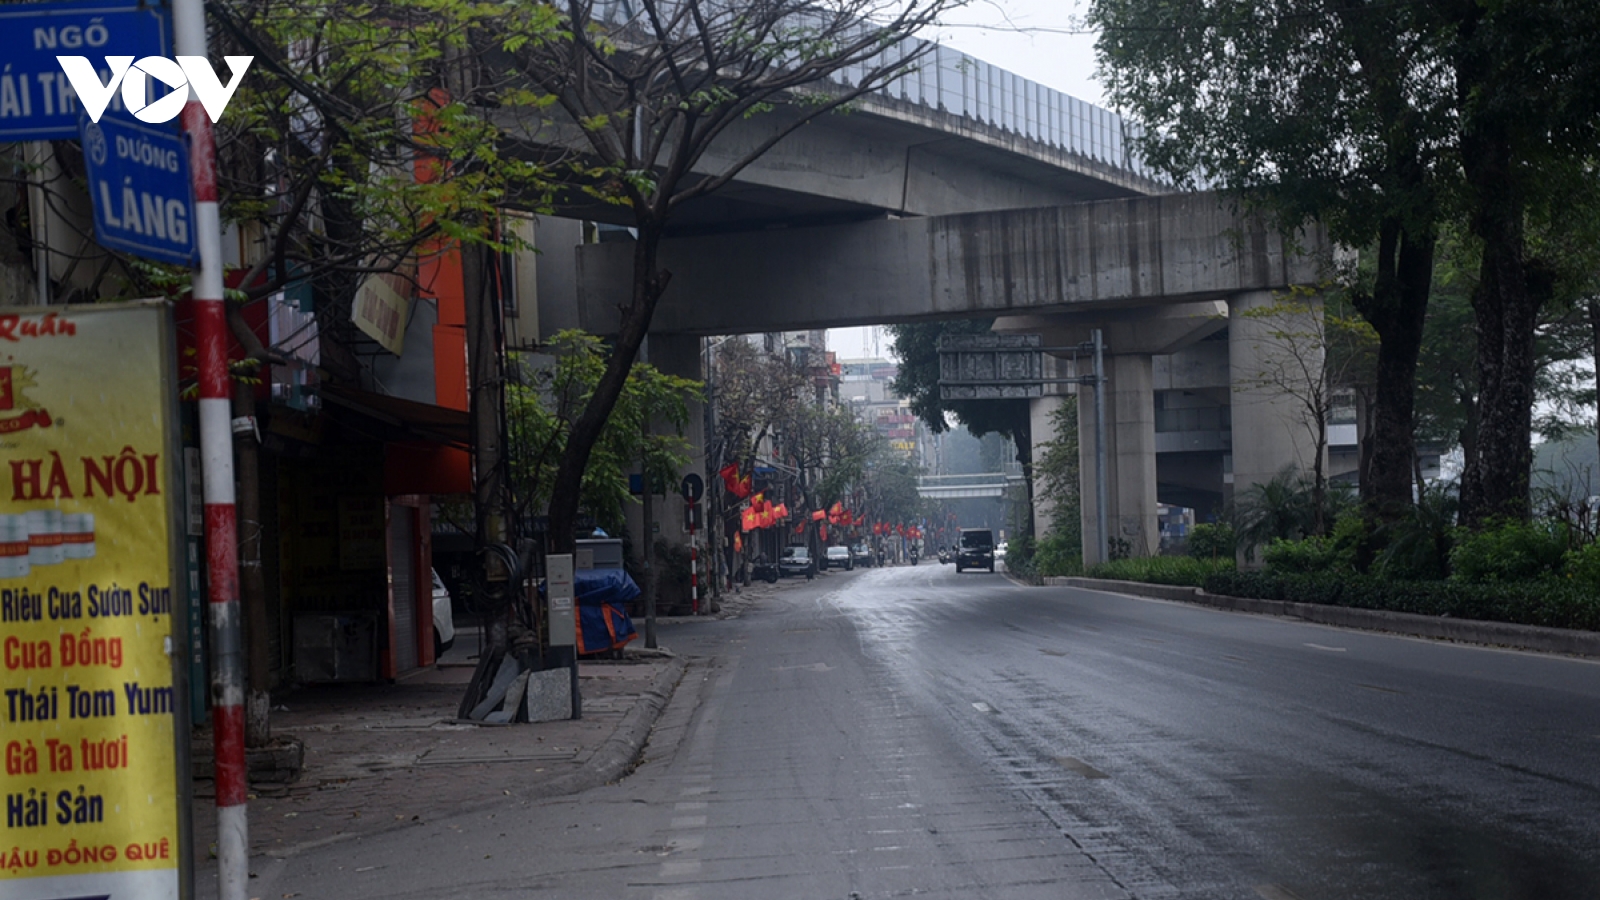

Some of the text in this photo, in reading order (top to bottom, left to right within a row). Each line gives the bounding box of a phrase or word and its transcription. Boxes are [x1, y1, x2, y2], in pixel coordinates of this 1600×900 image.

[33, 18, 109, 50] NGÕ
[100, 177, 189, 245] LÁNG
[9, 451, 74, 501] HÀ
[81, 446, 161, 502] NỘI
[2, 587, 42, 622] Riêu
[48, 586, 82, 620] Cua
[4, 626, 122, 670] Cua Đồng
[5, 682, 174, 722] Thái Tom Yum
[6, 735, 128, 776] Gà Ta tươi
[7, 785, 104, 828] Hải Sản
[46, 839, 117, 866] ĐỒNG
[125, 837, 169, 861] QUÊ
